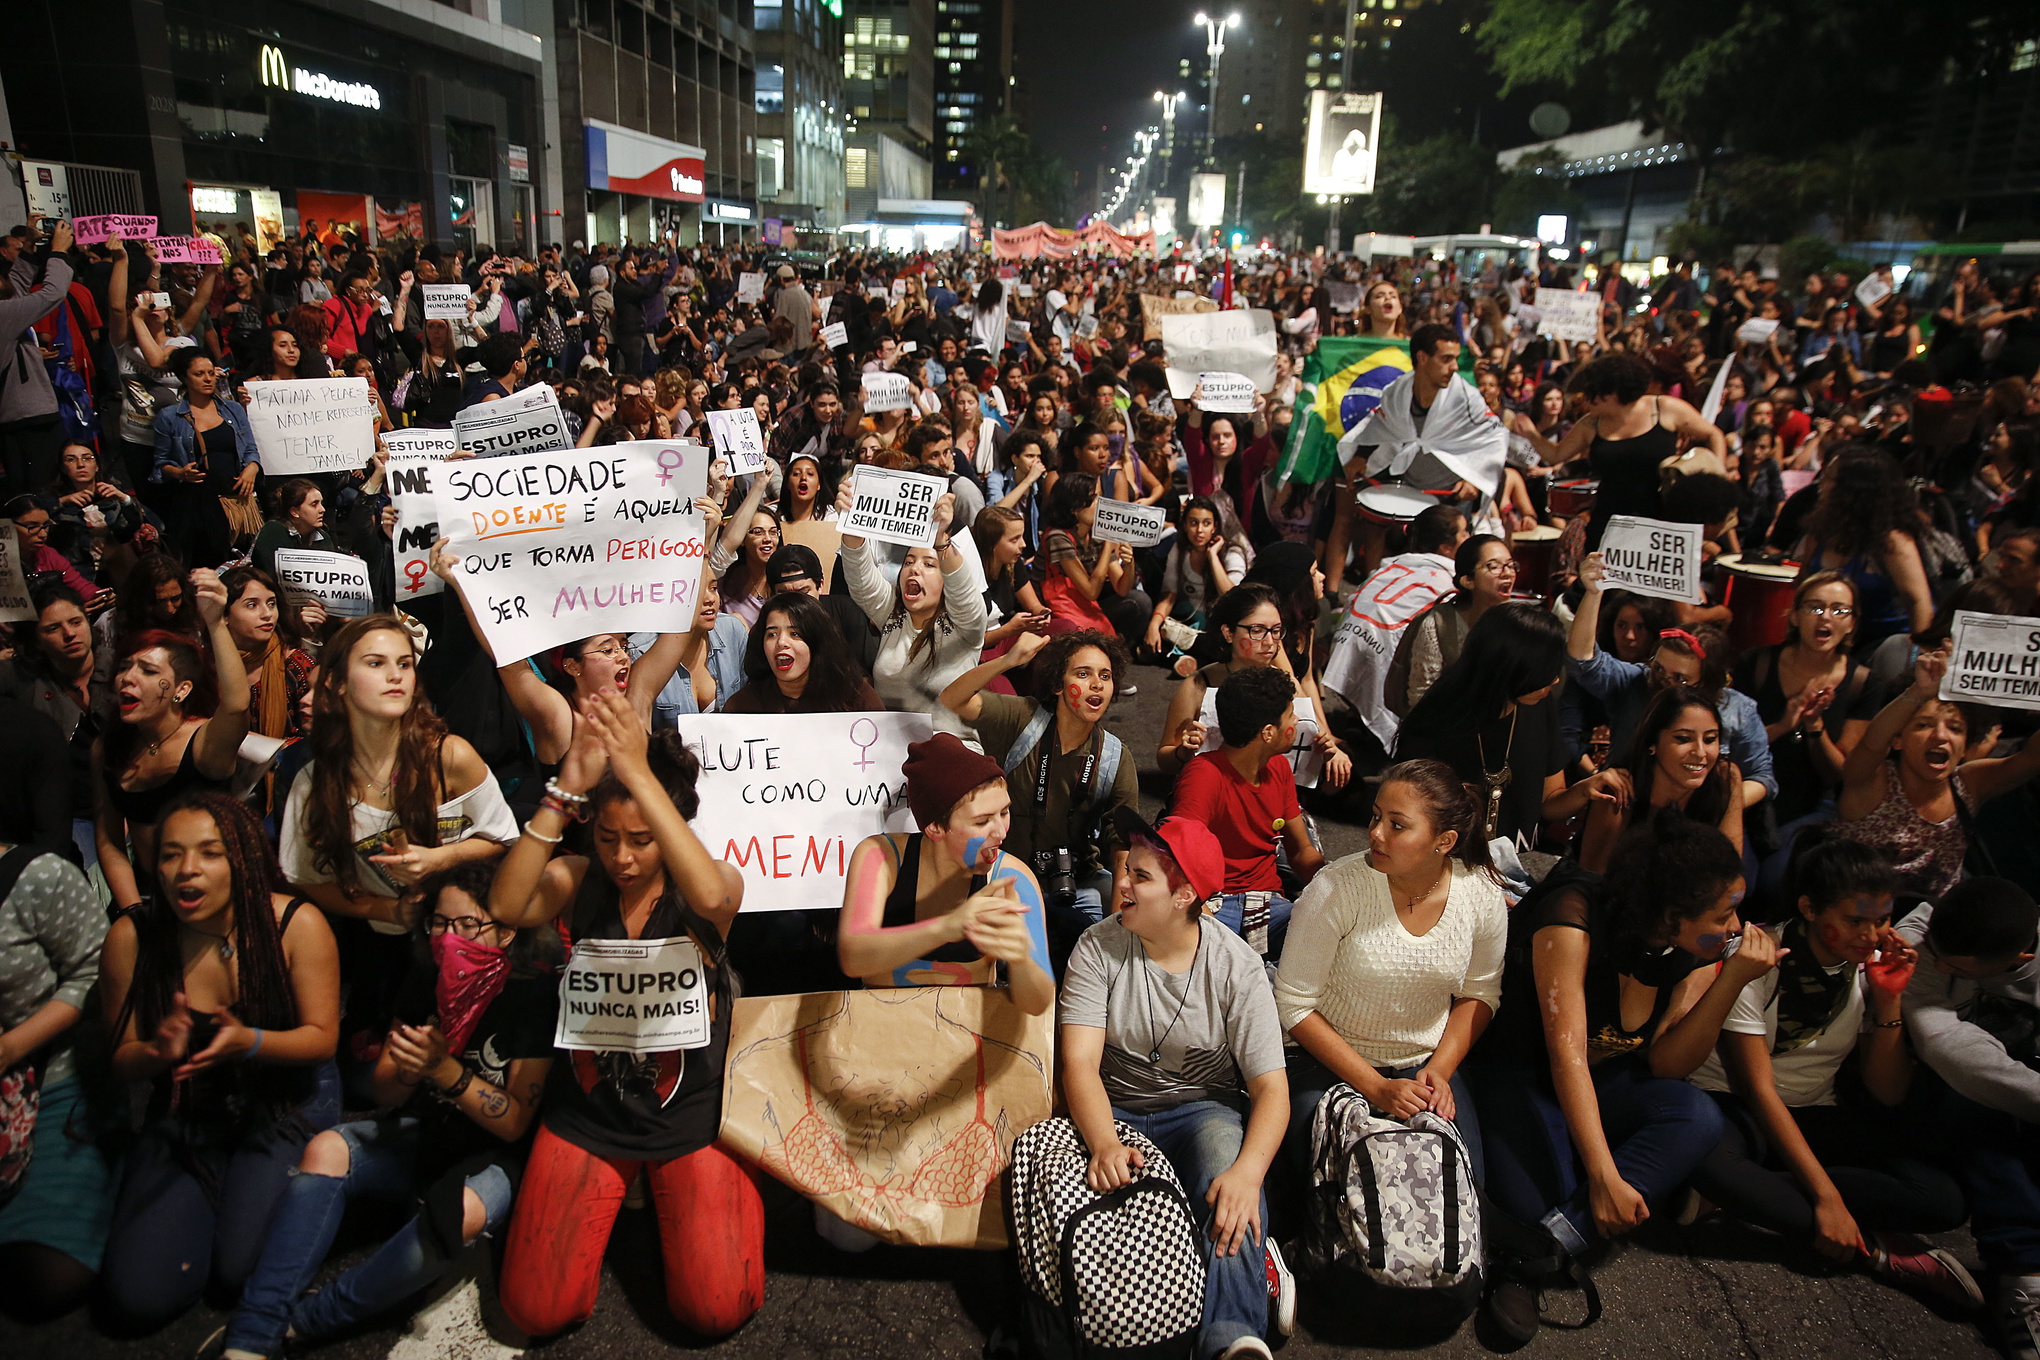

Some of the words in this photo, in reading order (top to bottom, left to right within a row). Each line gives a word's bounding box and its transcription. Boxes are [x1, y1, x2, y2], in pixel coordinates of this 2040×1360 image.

[295, 67, 381, 110] McDonald's
[112, 216, 156, 227] QUANDO
[123, 227, 148, 237] VÃO
[150, 237, 186, 249] TENTAR
[426, 293, 469, 301] ESTUPRO
[320, 385, 365, 403] PELAES
[1202, 383, 1253, 392] ESTUPRO
[326, 404, 374, 421] REPRESENTA
[737, 411, 755, 425] LUTA
[276, 434, 339, 459] TEMER
[388, 440, 455, 451] ESTUPRO
[461, 423, 558, 454] ESTUPRO
[521, 438, 563, 455] MAIS!
[740, 440, 757, 451] POR
[307, 447, 362, 471] JAMAIS!
[449, 458, 627, 501] SOCIEDADE
[898, 482, 933, 503] SER
[472, 502, 568, 536] DOENTE
[583, 496, 599, 523] É
[613, 496, 694, 523] AQUELA
[855, 495, 930, 522] MULHER
[1098, 509, 1159, 530] ESTUPRO
[851, 513, 878, 529] SEM
[881, 517, 926, 537] TEMER!
[1097, 521, 1129, 534] NUNCA
[1131, 529, 1157, 539] MAIS!
[464, 552, 513, 575] QUE
[527, 543, 595, 567] TORNA
[606, 535, 706, 562] PERIGOSO
[1650, 531, 1685, 555] SER
[1605, 547, 1685, 577] MULHER
[281, 569, 364, 586] ESTUPRO
[1606, 567, 1633, 583] SEM
[1634, 573, 1686, 592] TEMER!
[331, 590, 366, 600] MAIS!
[488, 595, 530, 625] SER
[552, 578, 697, 619] MULHER!
[1963, 650, 2040, 677] MULH
[1959, 674, 1998, 692] SEM
[2002, 678, 2040, 697] TEM
[700, 735, 781, 772] LUTE
[1039, 754, 1049, 785] DIGITAL
[1081, 754, 1095, 784] Canon
[742, 778, 826, 804] COMO
[845, 781, 910, 809] UMA
[568, 968, 699, 995] ESTUPRO
[570, 1000, 638, 1020] NUNCA
[643, 998, 701, 1019] MAIS!
